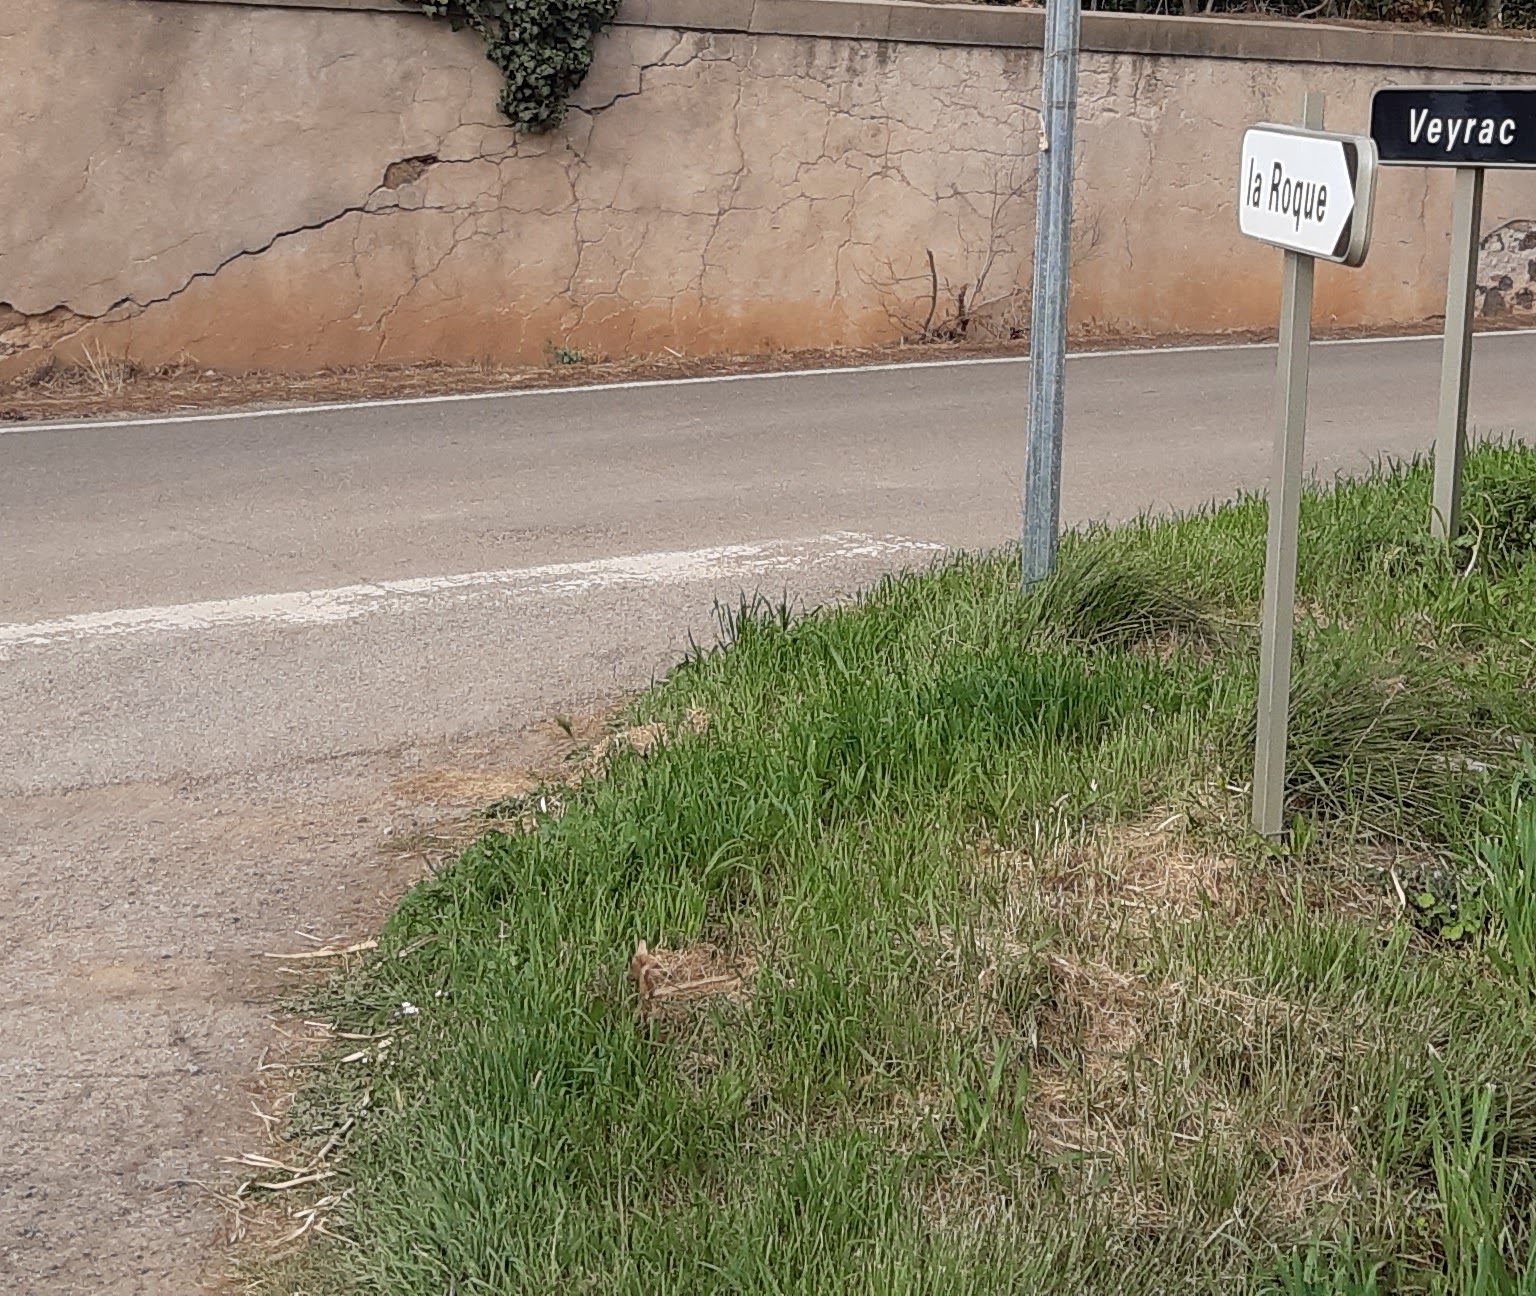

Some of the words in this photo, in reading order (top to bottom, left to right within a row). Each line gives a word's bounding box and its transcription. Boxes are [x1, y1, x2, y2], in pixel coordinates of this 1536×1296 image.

[1409, 109, 1516, 152] Veyrac
[1247, 157, 1261, 208] la
[1268, 162, 1327, 232] Roque
